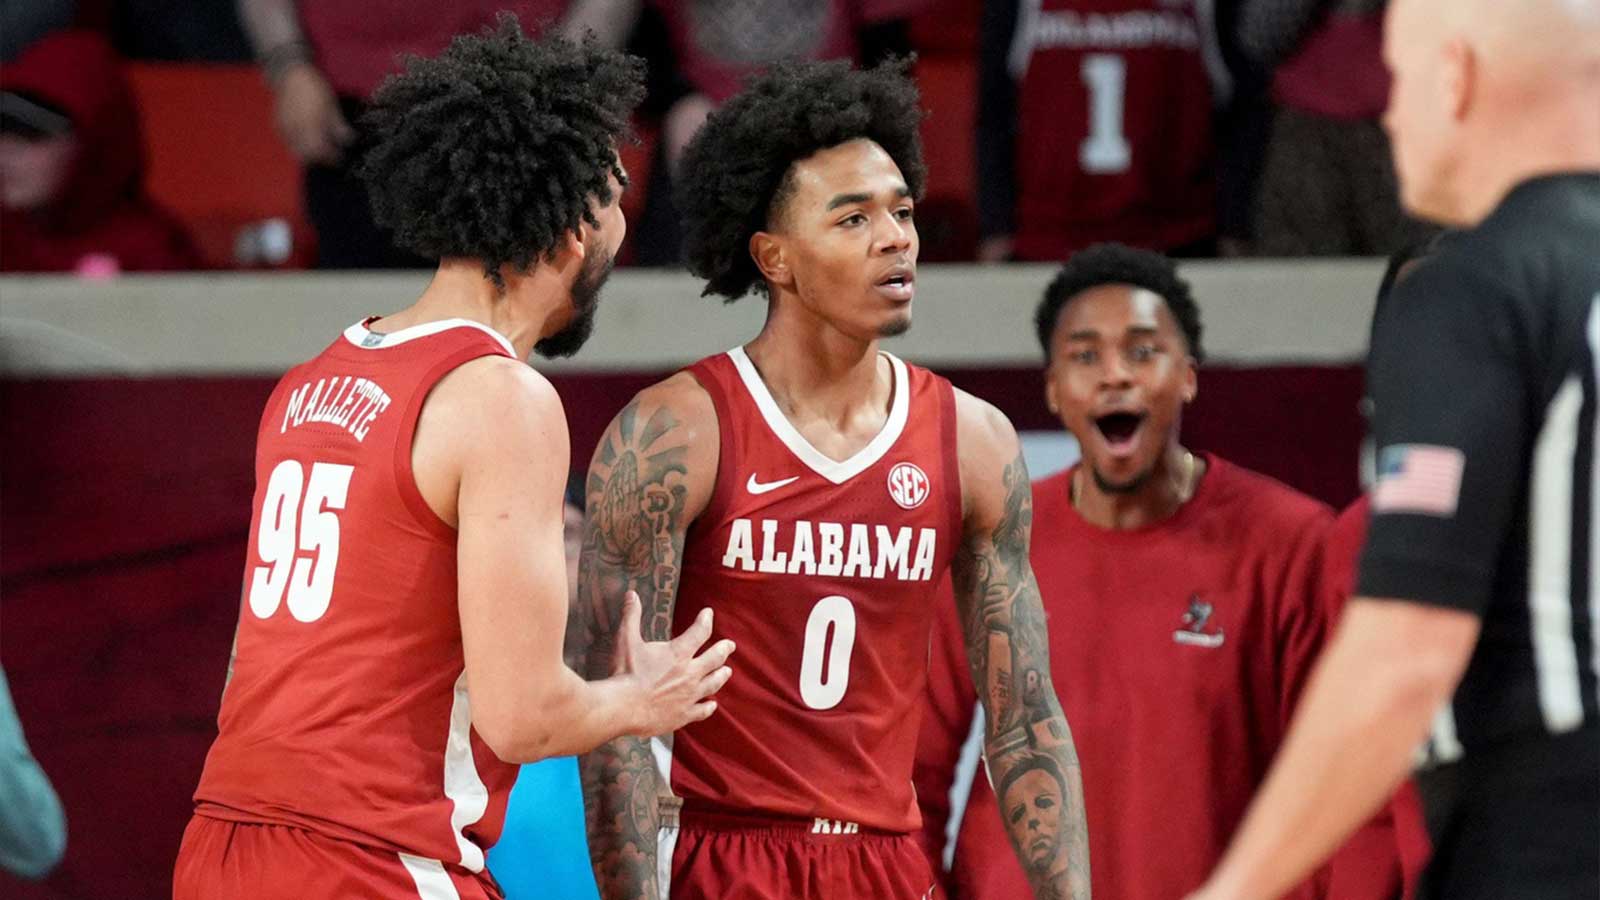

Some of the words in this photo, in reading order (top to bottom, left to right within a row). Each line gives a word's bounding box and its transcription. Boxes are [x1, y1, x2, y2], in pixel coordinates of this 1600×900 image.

[1080, 54, 1132, 173] 1
[281, 376, 392, 443] MALLETTE
[891, 466, 926, 505] SEC
[249, 460, 355, 623] 95
[722, 519, 936, 581] ALABAMA
[800, 595, 856, 710] 0
